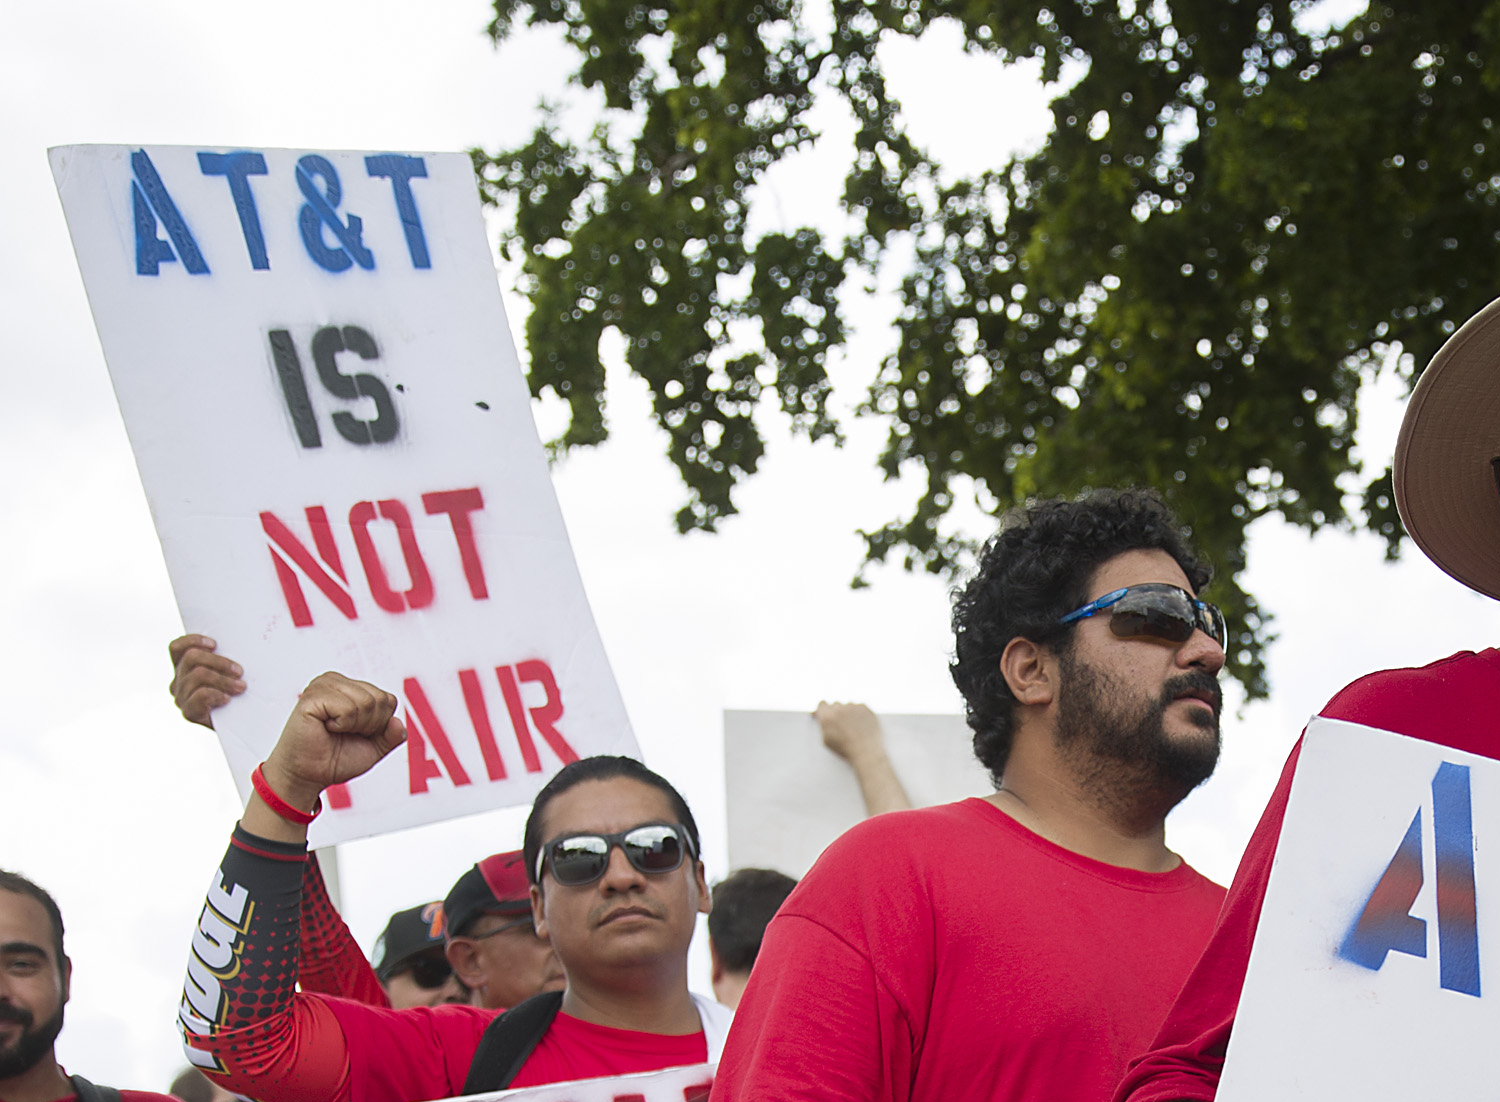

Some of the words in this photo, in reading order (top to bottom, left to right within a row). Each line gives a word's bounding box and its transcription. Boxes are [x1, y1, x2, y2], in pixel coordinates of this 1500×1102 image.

[130, 148, 433, 277] AT&T
[267, 326, 401, 450] IS
[259, 487, 490, 628] NOT
[298, 658, 582, 811] AIR
